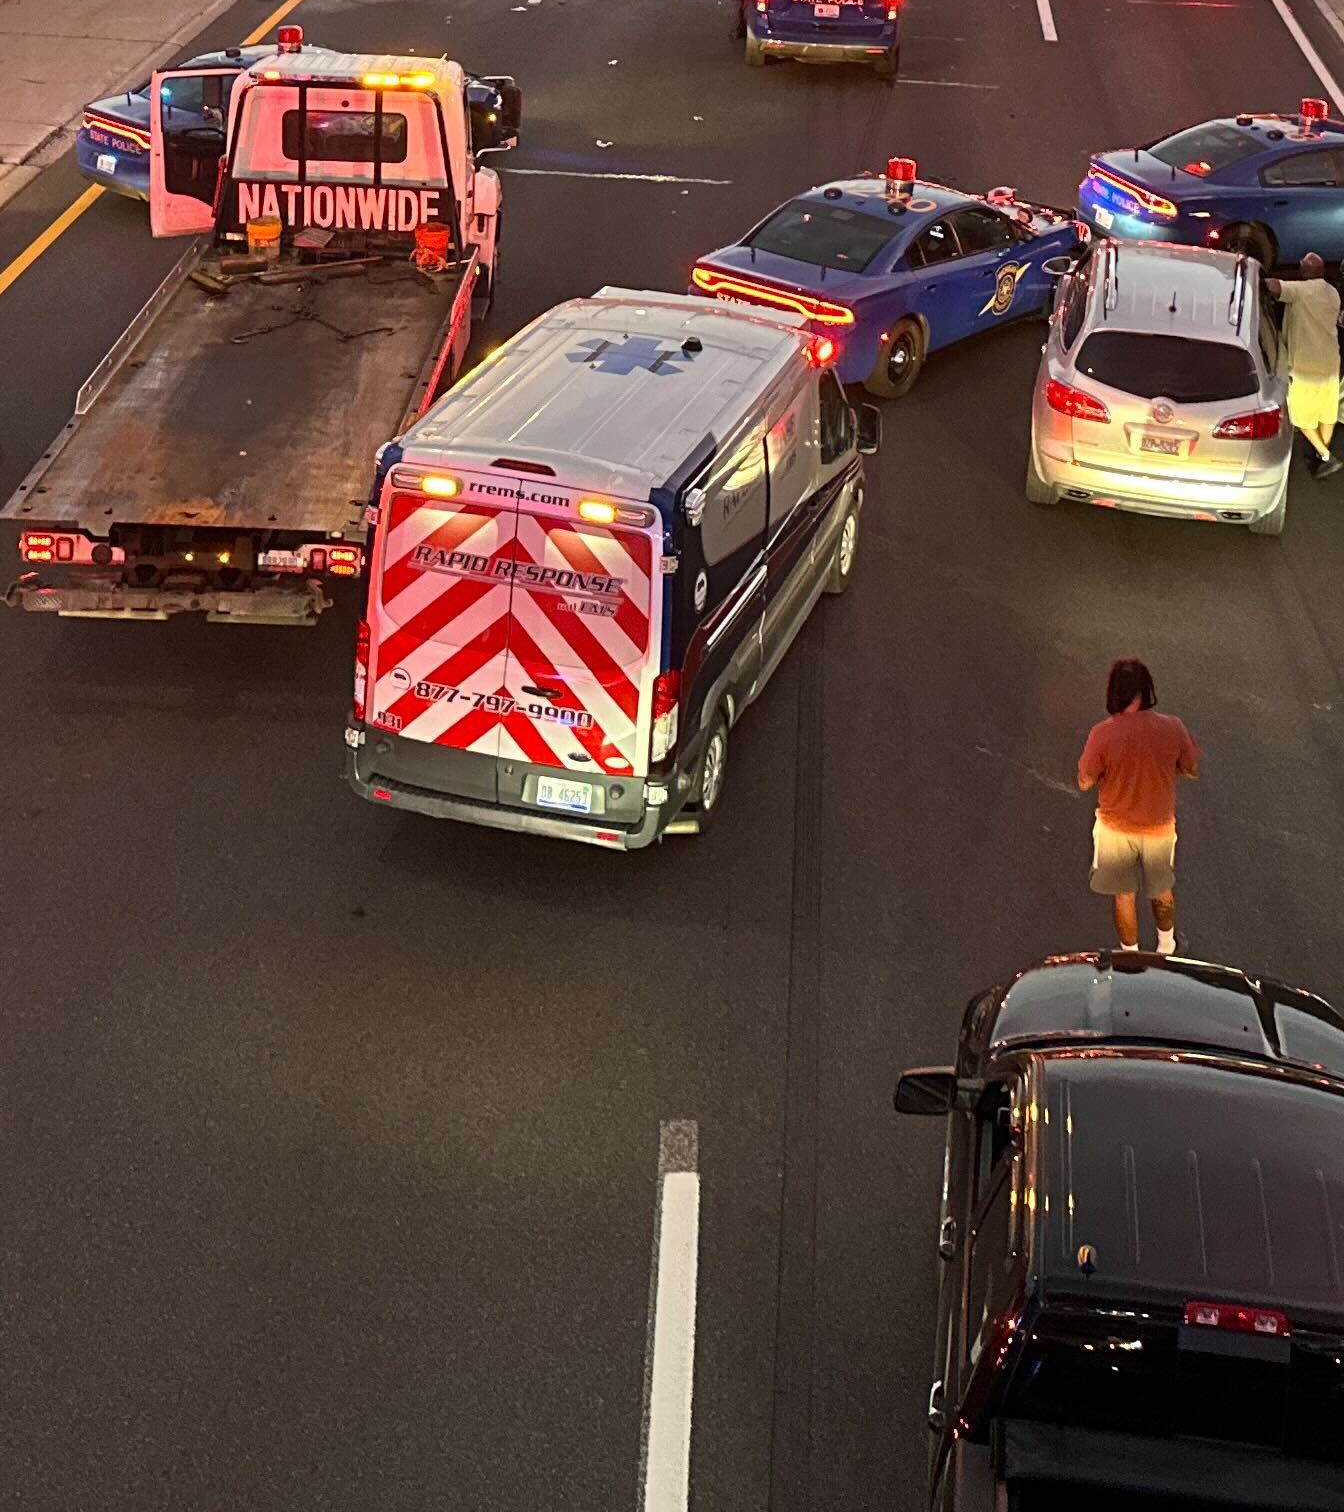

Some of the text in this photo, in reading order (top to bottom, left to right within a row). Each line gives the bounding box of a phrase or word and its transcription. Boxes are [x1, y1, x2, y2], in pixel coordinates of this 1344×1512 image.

[112, 137, 143, 156] POLICE
[238, 182, 440, 232] NATIONWIDE
[469, 482, 570, 508] rrems.com
[414, 544, 625, 594] RAPID RESPONSE
[415, 681, 594, 729] 877-797-9900
